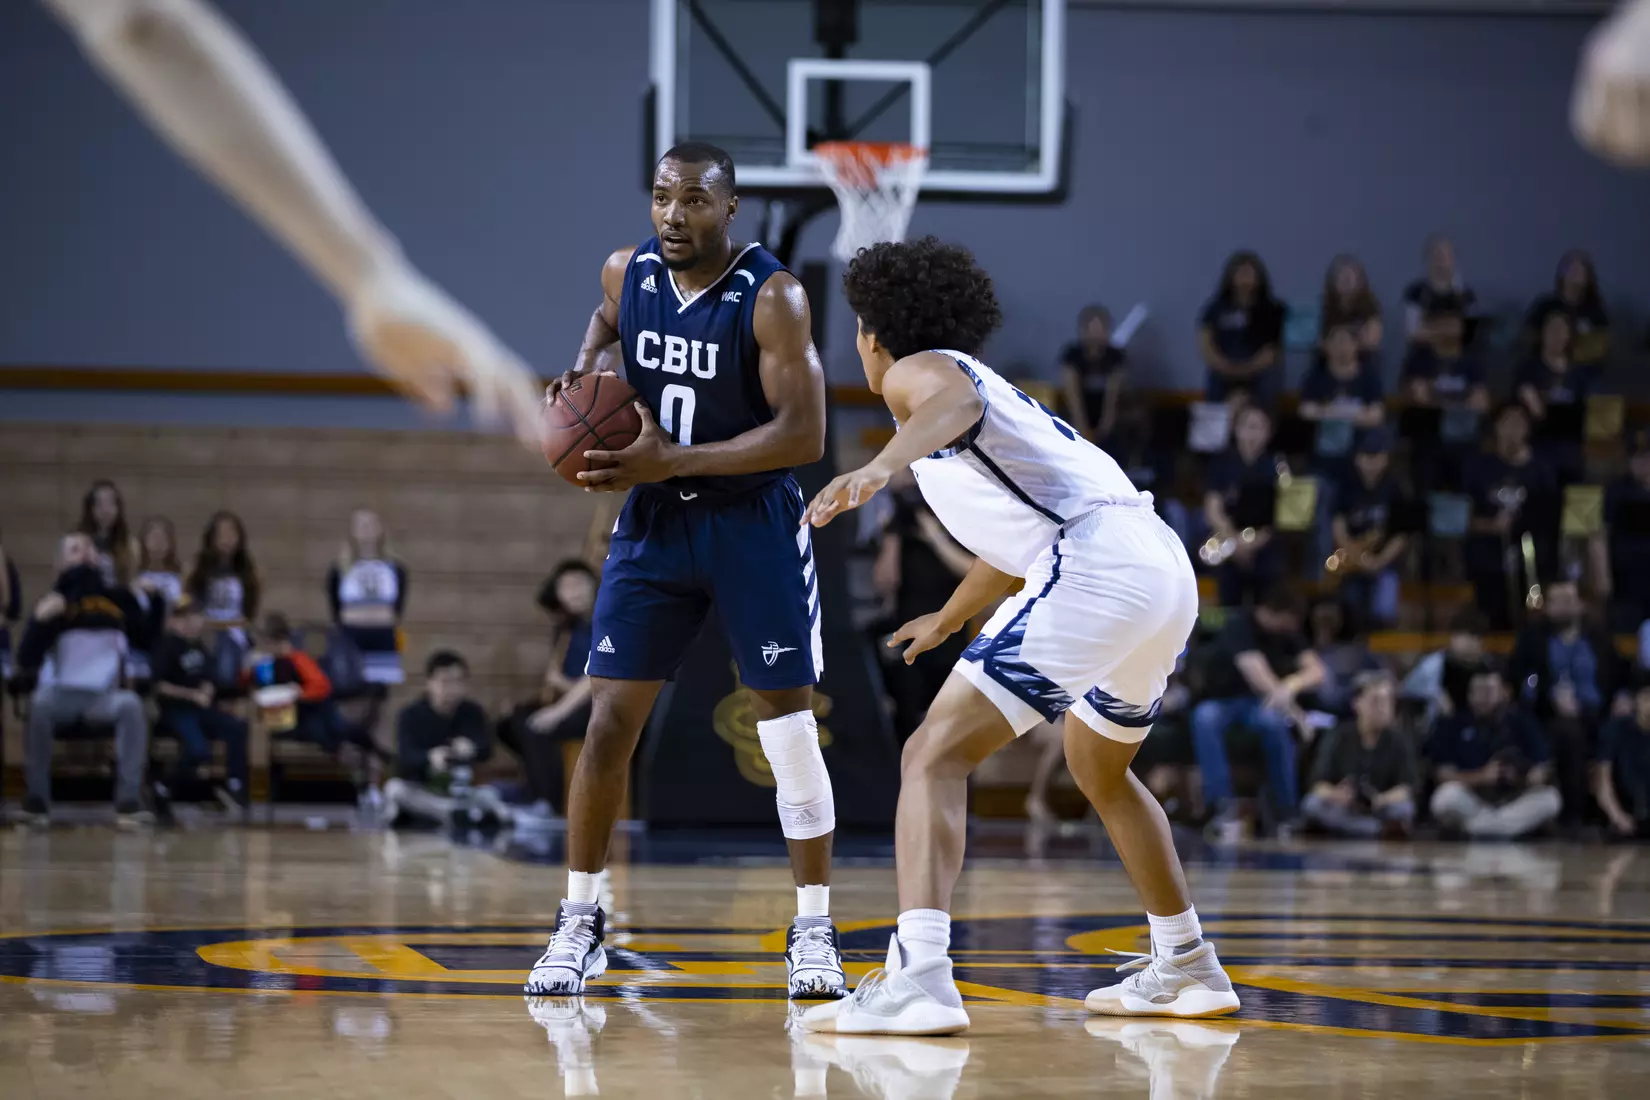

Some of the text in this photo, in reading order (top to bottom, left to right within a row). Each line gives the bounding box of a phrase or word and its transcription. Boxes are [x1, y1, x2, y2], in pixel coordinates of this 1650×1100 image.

[640, 282, 658, 294] adidas
[721, 291, 742, 302] WAC
[636, 330, 719, 379] CBU
[660, 384, 696, 446] 0
[596, 645, 615, 653] adidas
[793, 816, 821, 826] adidas
